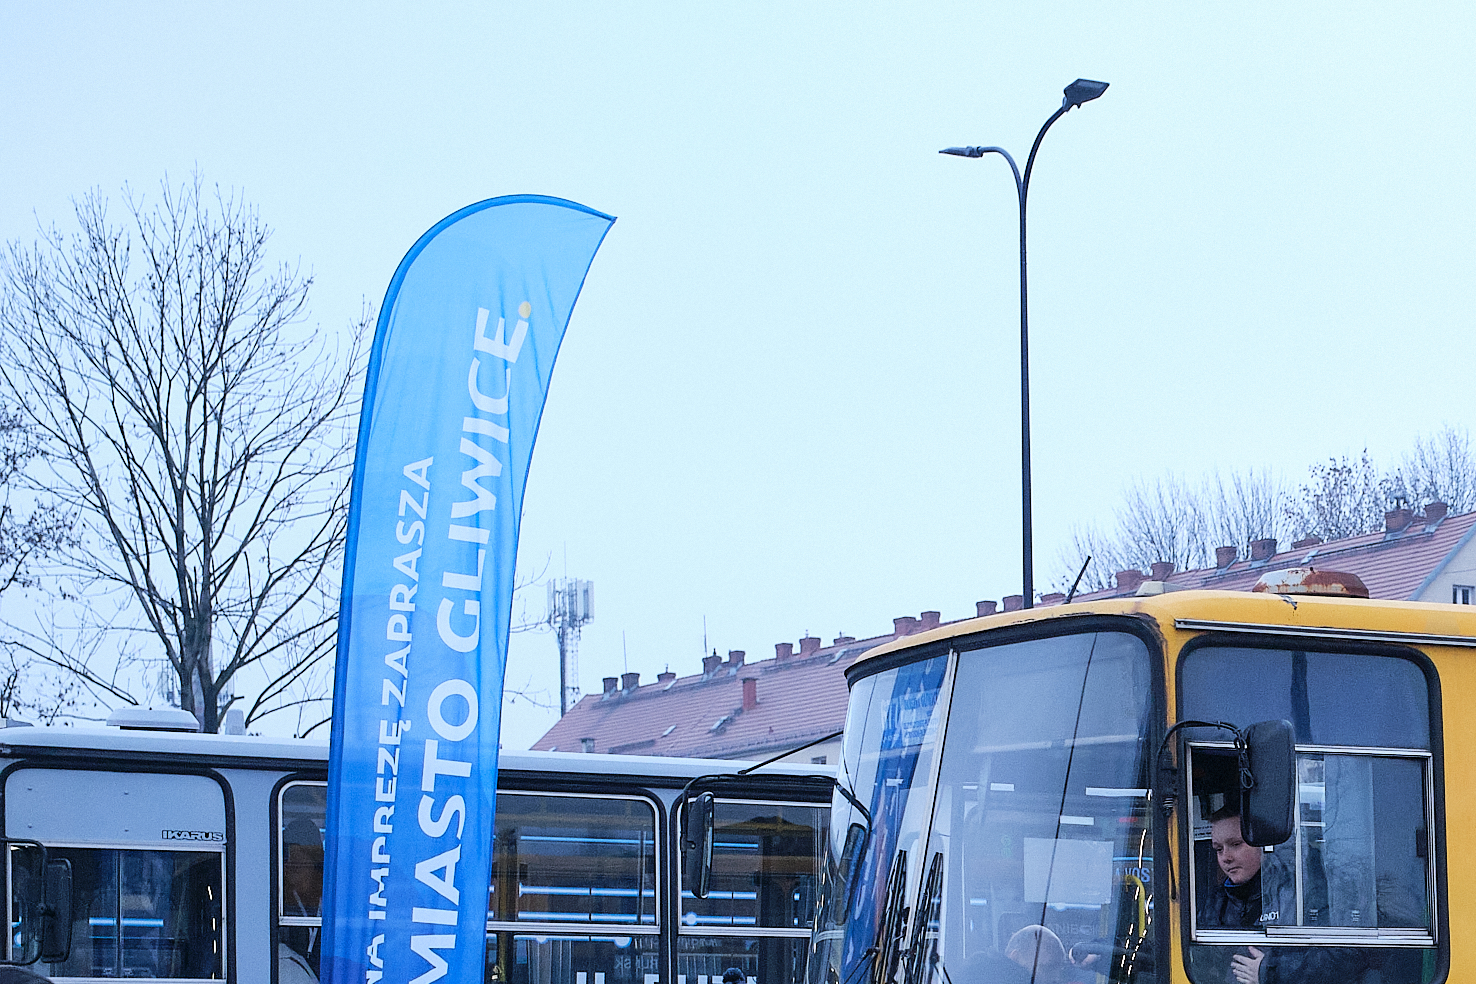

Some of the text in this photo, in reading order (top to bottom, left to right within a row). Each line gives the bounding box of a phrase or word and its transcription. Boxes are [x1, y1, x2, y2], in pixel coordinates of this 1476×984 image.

[381, 456, 433, 708] ZAPRASZA
[437, 301, 531, 652] GLIWICE.
[162, 829, 224, 842] IKARUS
[368, 719, 411, 920] IMPREZĘ
